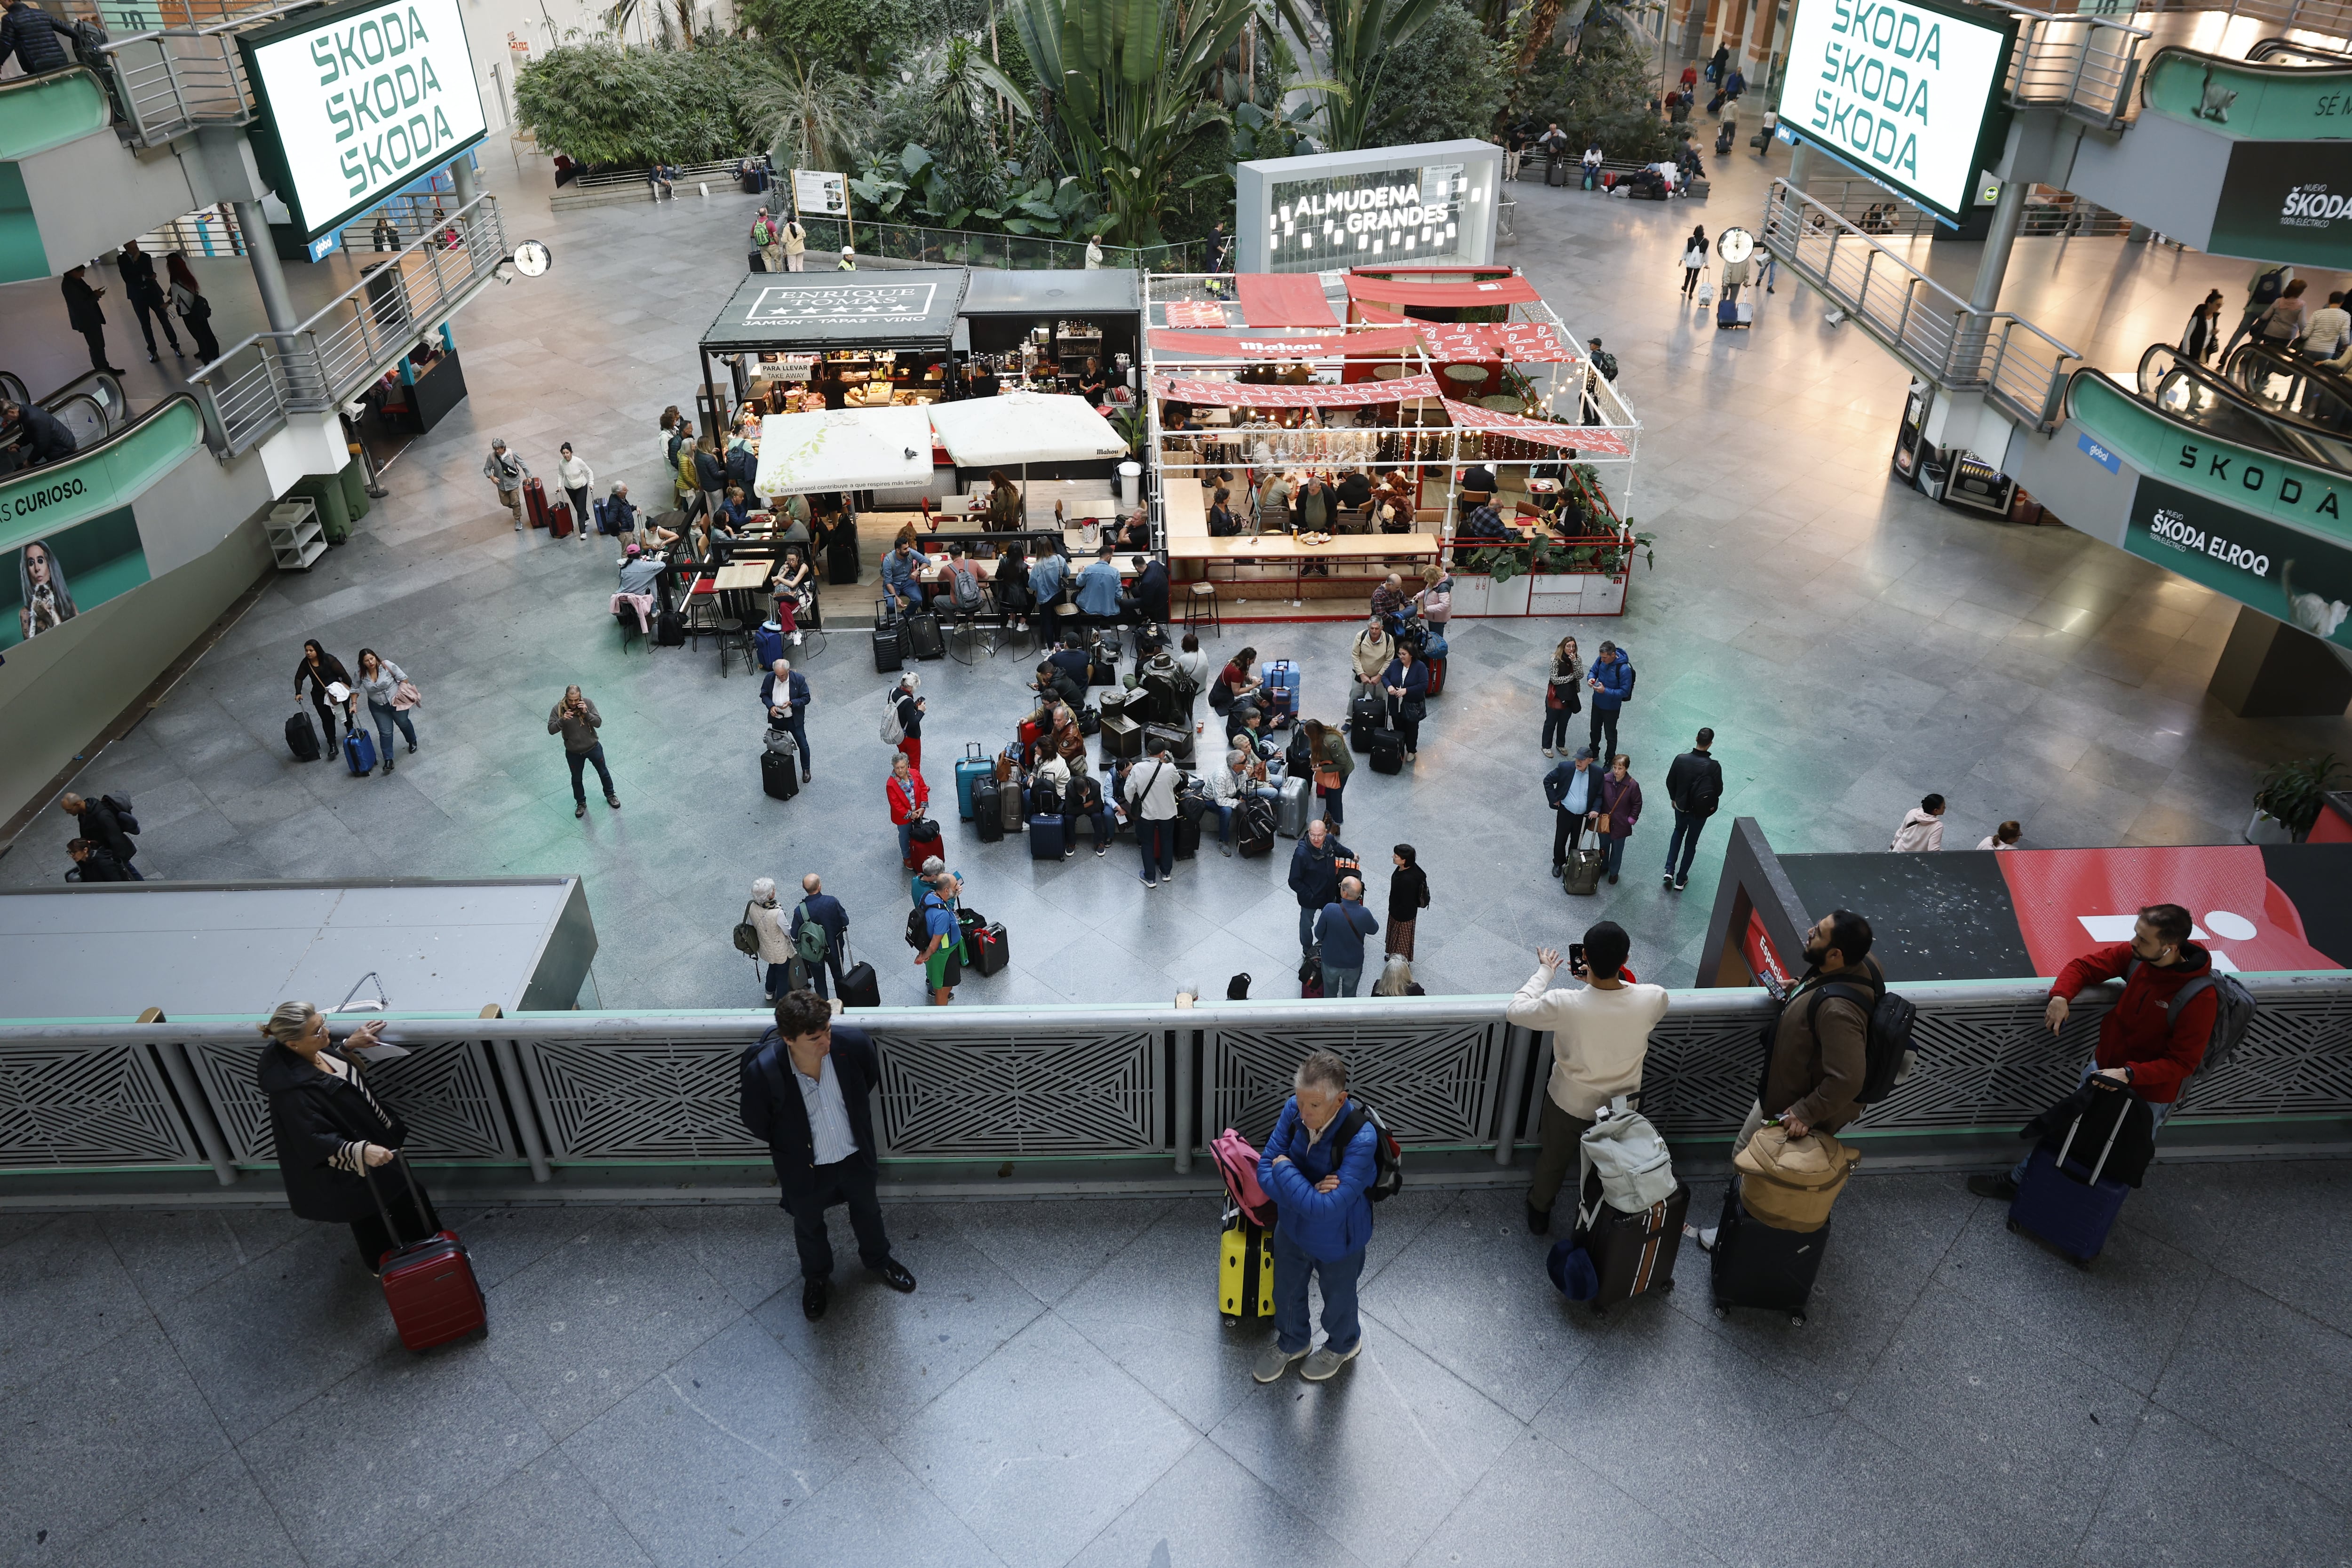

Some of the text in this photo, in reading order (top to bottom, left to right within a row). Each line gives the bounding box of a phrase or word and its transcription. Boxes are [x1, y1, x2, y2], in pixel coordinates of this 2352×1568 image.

[2315, 90, 2341, 116] SÉ
[2304, 183, 2327, 192] NUEVO
[1295, 183, 1420, 217] ALMUDENA
[1346, 203, 1448, 233] GRANDES
[2280, 217, 2329, 228] 100% ELÉCTRICO
[316, 234, 333, 258] global
[778, 288, 915, 299] ENRIQUE
[1239, 342, 1324, 350] Mahou
[2090, 444, 2109, 462] global
[0, 478, 87, 523] S CURIOSO.
[2166, 509, 2184, 520] NUEVO
[2149, 533, 2186, 552] 100% ELÉCTRICO
[2151, 509, 2270, 576] ŠKODA ELROQ
